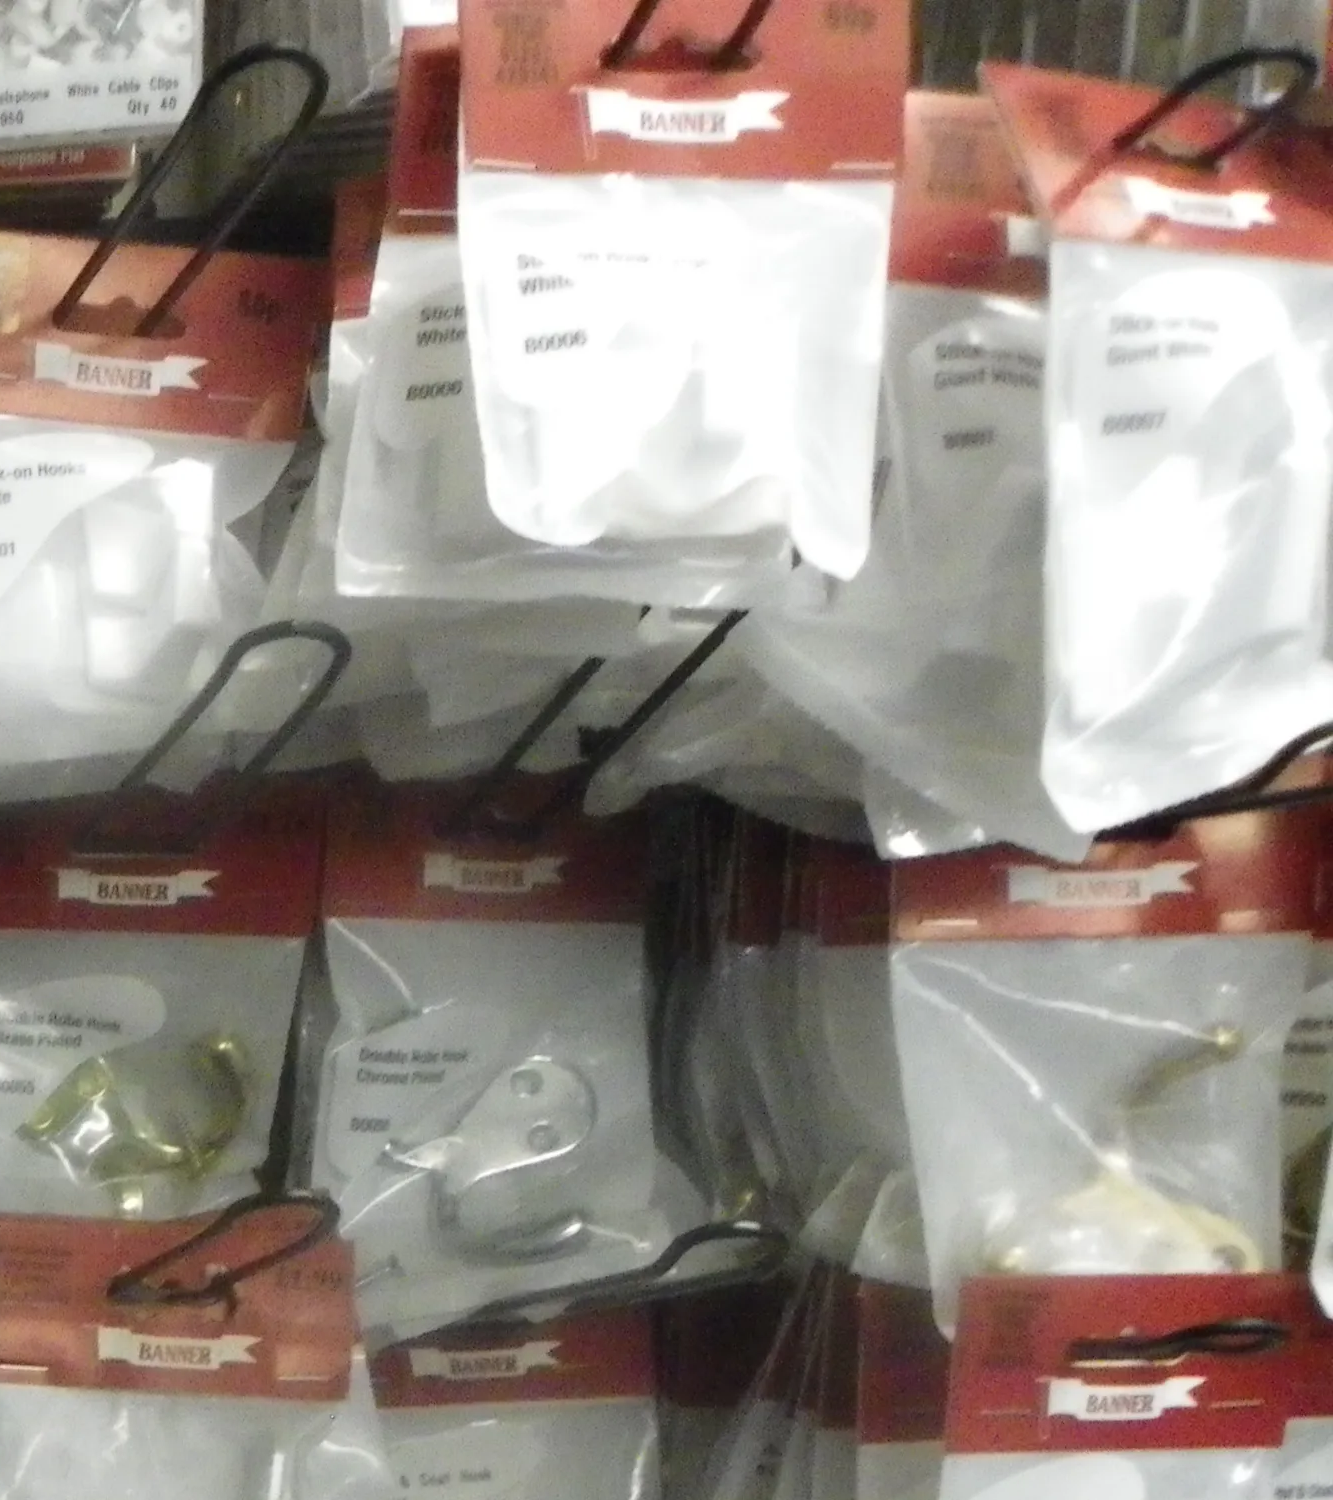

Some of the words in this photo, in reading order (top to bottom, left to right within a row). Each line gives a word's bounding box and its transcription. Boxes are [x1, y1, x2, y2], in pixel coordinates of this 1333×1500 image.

[640, 109, 726, 134] BANNER
[77, 362, 154, 390] BANNER
[97, 882, 170, 901] BANNER
[138, 1341, 212, 1364] BANNER
[1085, 1394, 1154, 1414] BANNER
